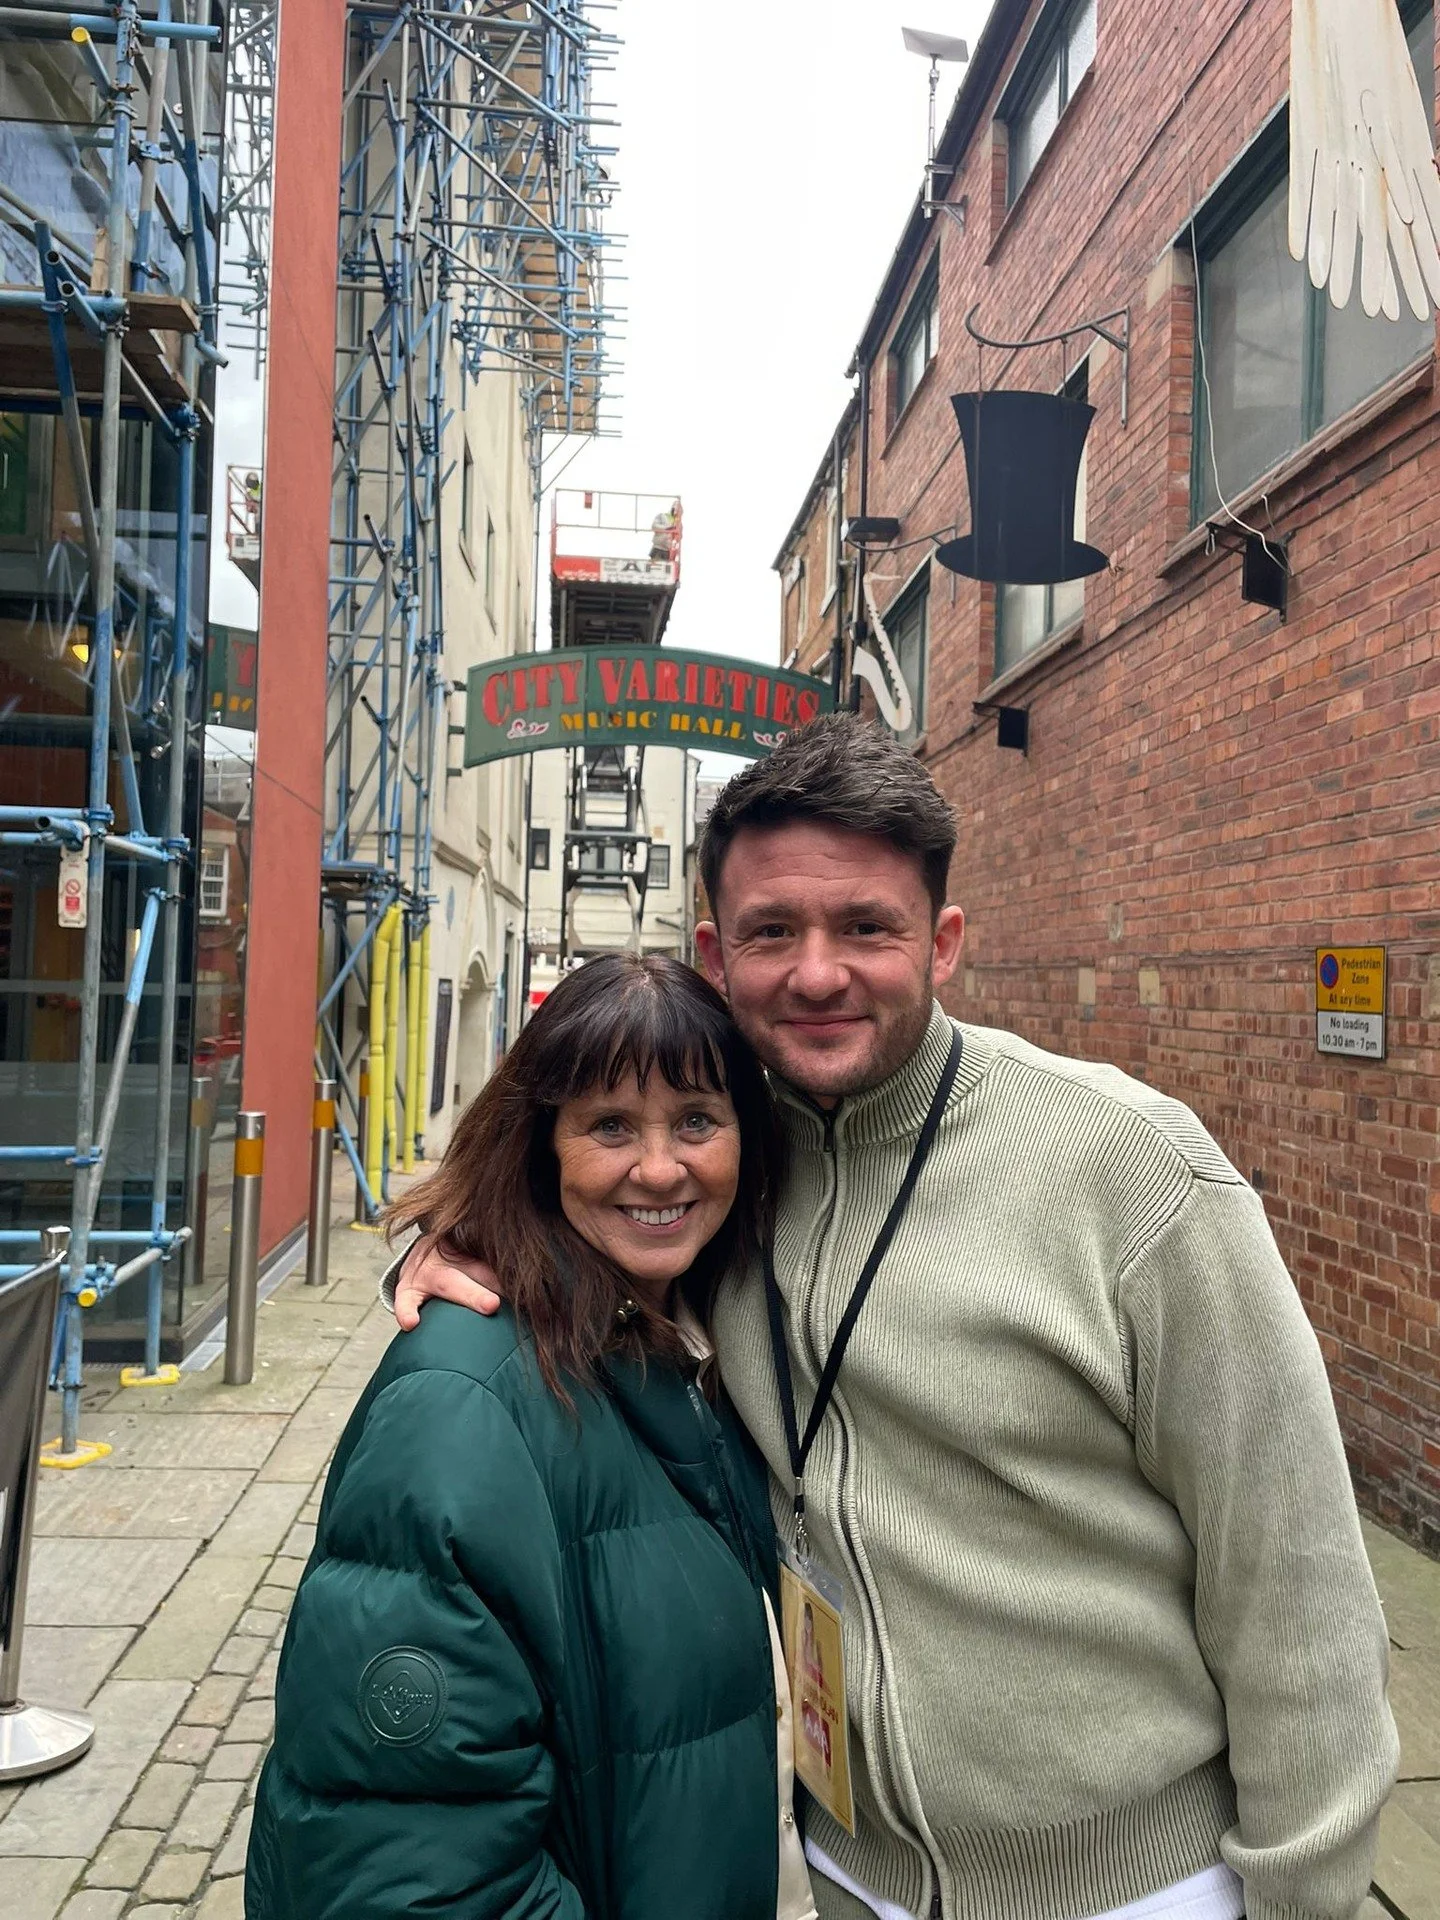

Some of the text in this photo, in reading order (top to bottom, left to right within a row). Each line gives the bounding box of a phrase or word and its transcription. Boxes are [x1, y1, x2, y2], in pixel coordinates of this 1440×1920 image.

[482, 658, 820, 735] CITY VARIETIES
[560, 710, 747, 740] MUSIC HALL
[1341, 958, 1380, 970] Pedestrian
[1352, 972, 1369, 985] Zone
[1329, 993, 1371, 1007] At any time
[1330, 1017, 1369, 1033] No loading
